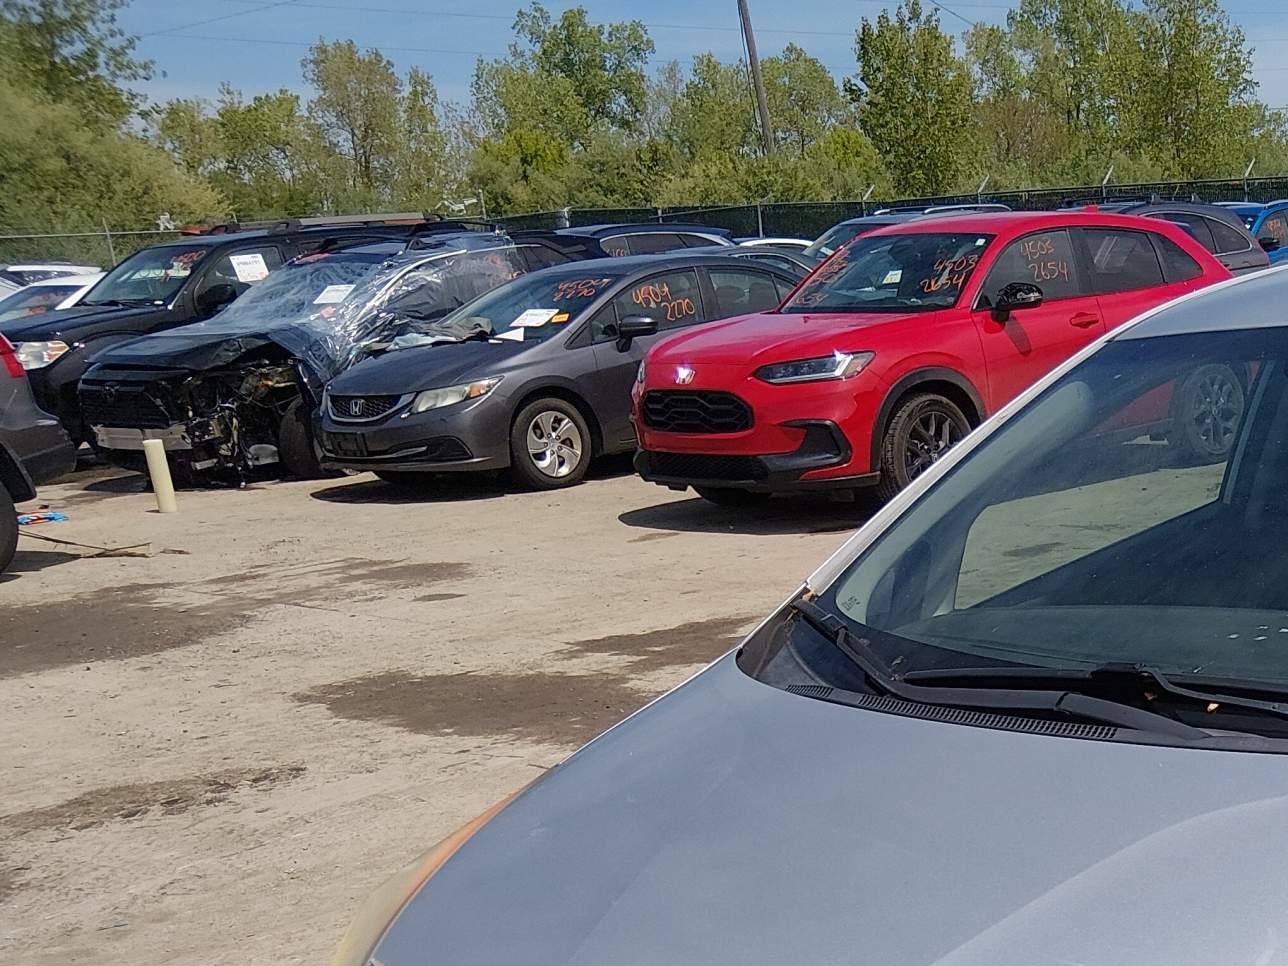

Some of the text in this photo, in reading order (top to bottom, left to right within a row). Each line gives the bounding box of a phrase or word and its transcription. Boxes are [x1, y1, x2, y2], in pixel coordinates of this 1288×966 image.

[919, 271, 967, 293] 2654
[1028, 260, 1069, 282] 2654
[632, 282, 672, 309] 4504
